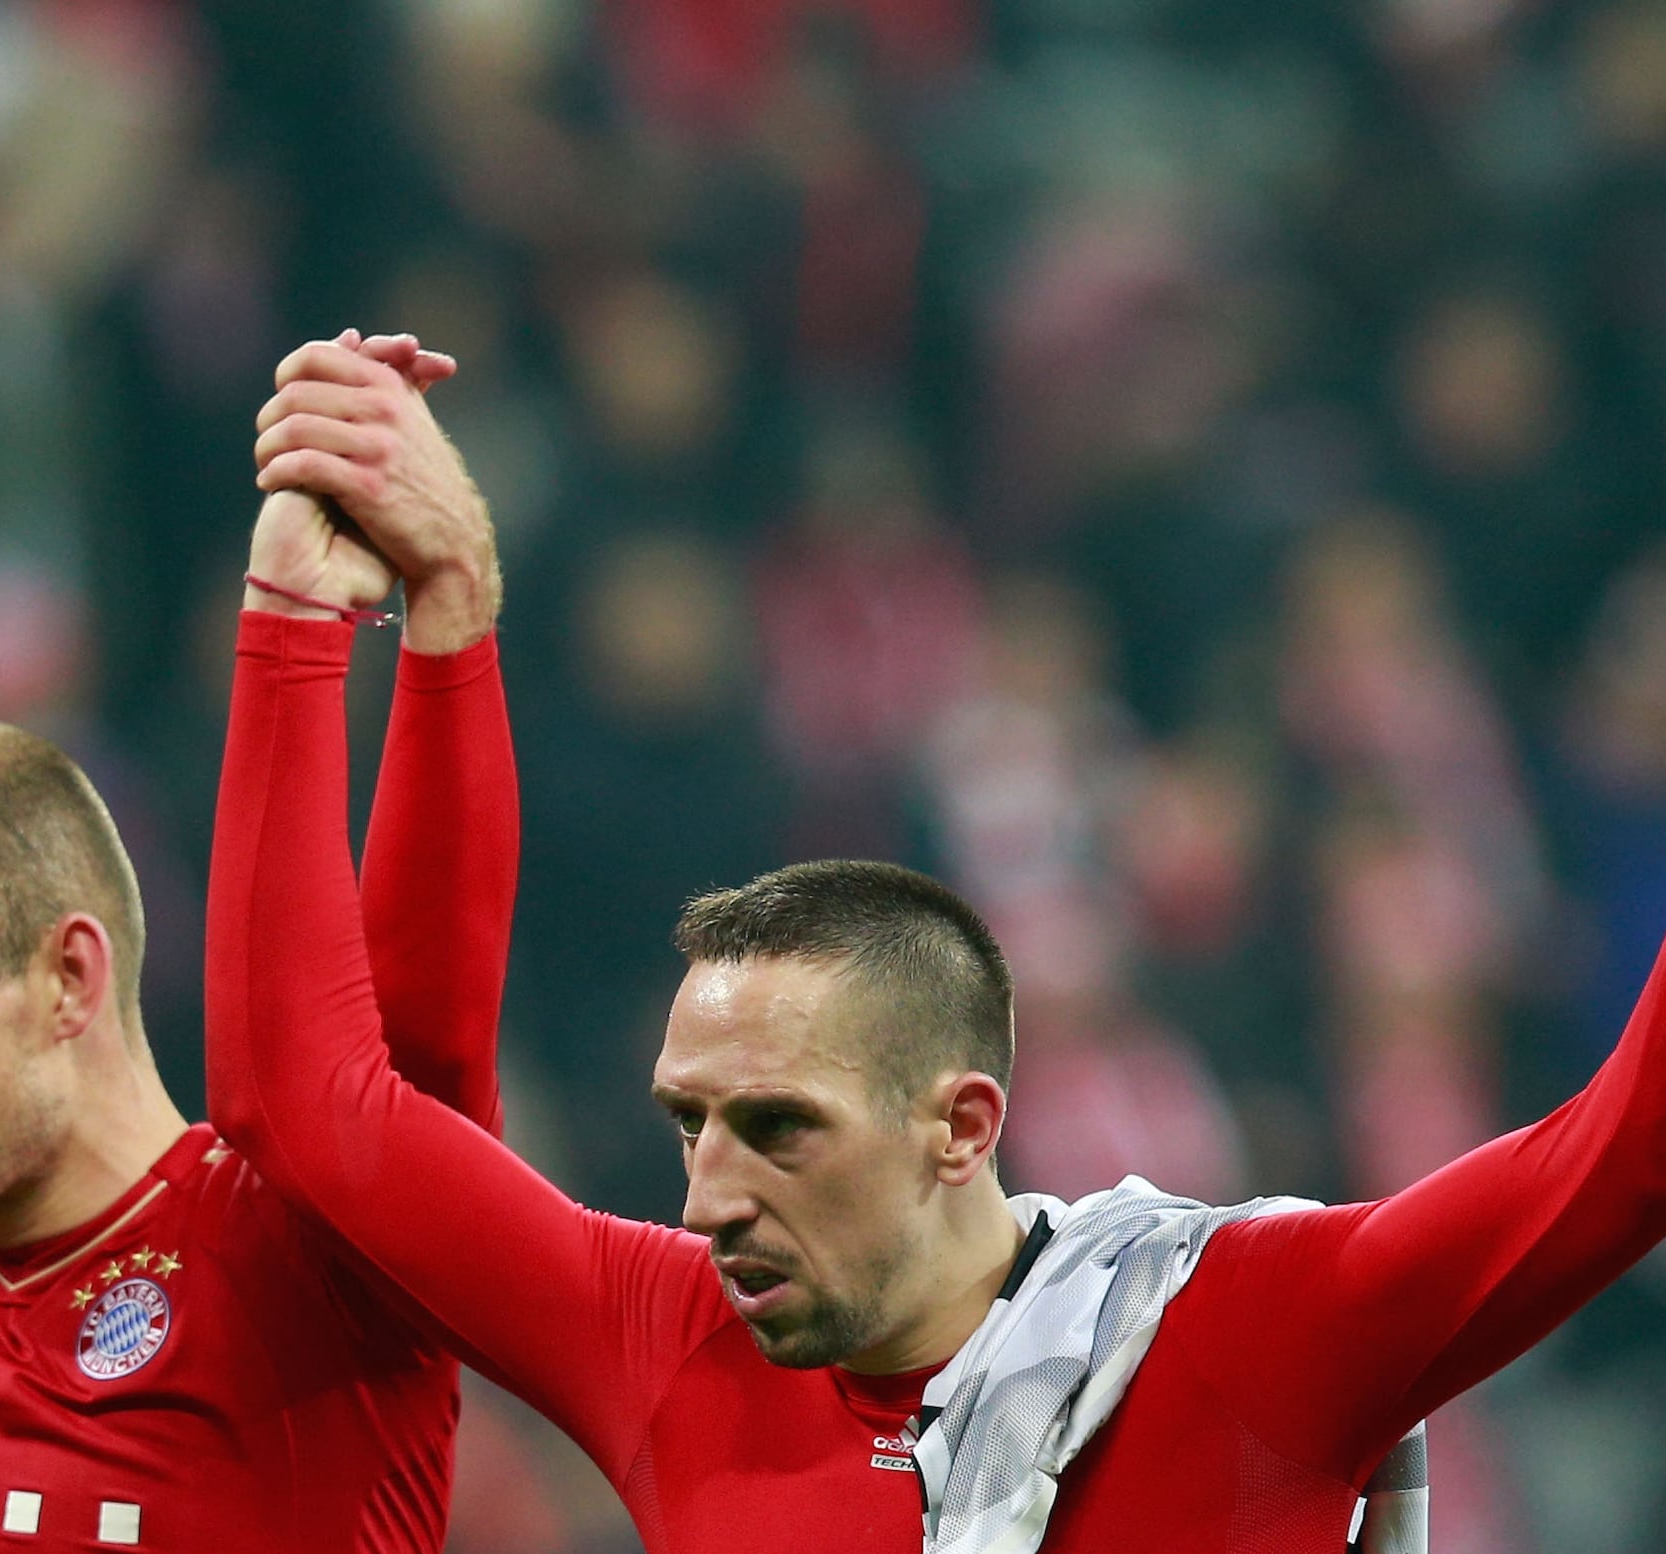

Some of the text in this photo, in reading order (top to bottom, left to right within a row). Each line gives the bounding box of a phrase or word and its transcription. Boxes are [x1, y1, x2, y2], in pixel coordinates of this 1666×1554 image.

[83, 1284, 165, 1338] FC BAYERN
[874, 1457, 916, 1470] TECH
